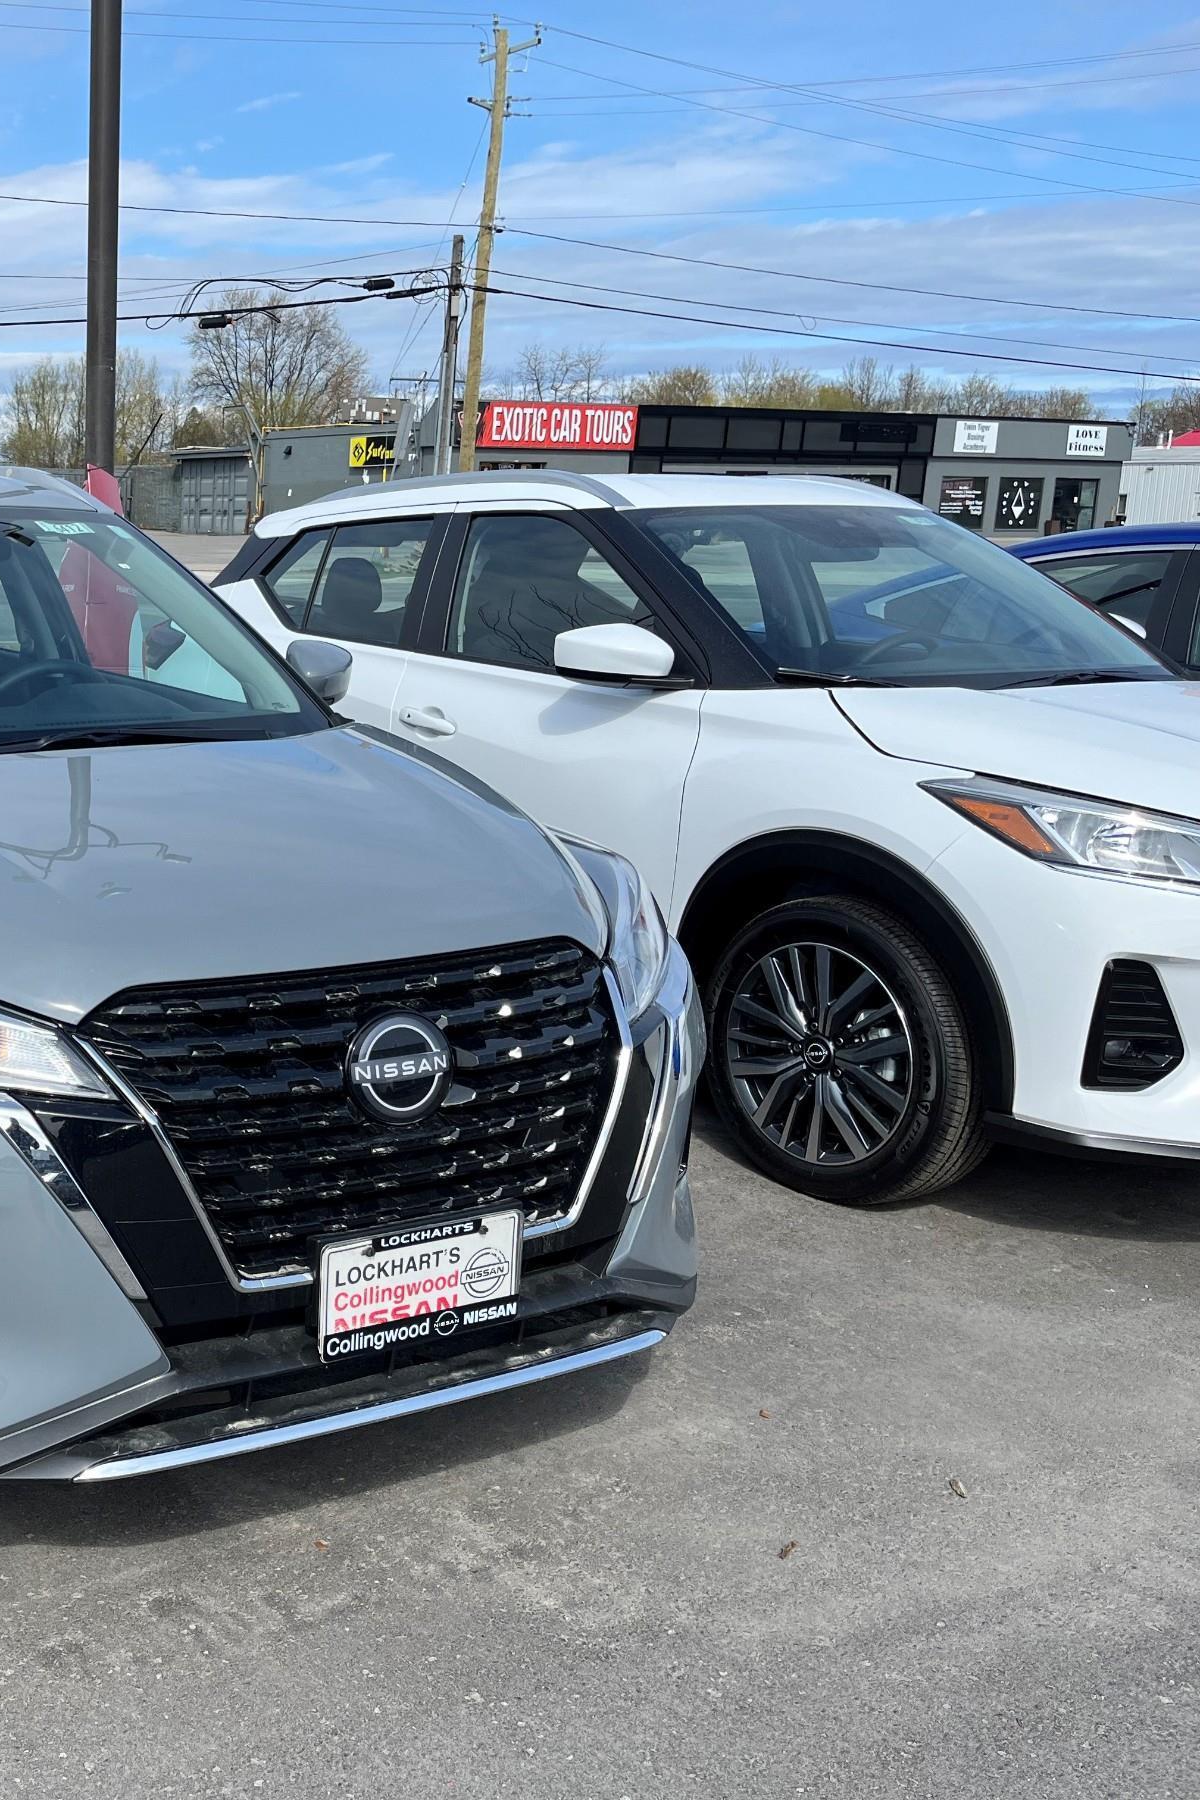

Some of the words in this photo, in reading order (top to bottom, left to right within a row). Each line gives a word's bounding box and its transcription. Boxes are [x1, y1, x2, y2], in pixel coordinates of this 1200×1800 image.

[491, 406, 547, 442] EXOTIC
[550, 408, 581, 443] CAR
[585, 409, 634, 445] TOURS
[1075, 429, 1101, 439] LOVE
[1068, 442, 1104, 453] Fitness
[354, 1054, 447, 1082] NISSAN
[335, 1246, 461, 1287] LOCKHART'S
[465, 1265, 505, 1281] NISSAN
[334, 1268, 459, 1312] Collingwood
[326, 1318, 430, 1357] Collingwood
[463, 1302, 518, 1326] NISSAN
